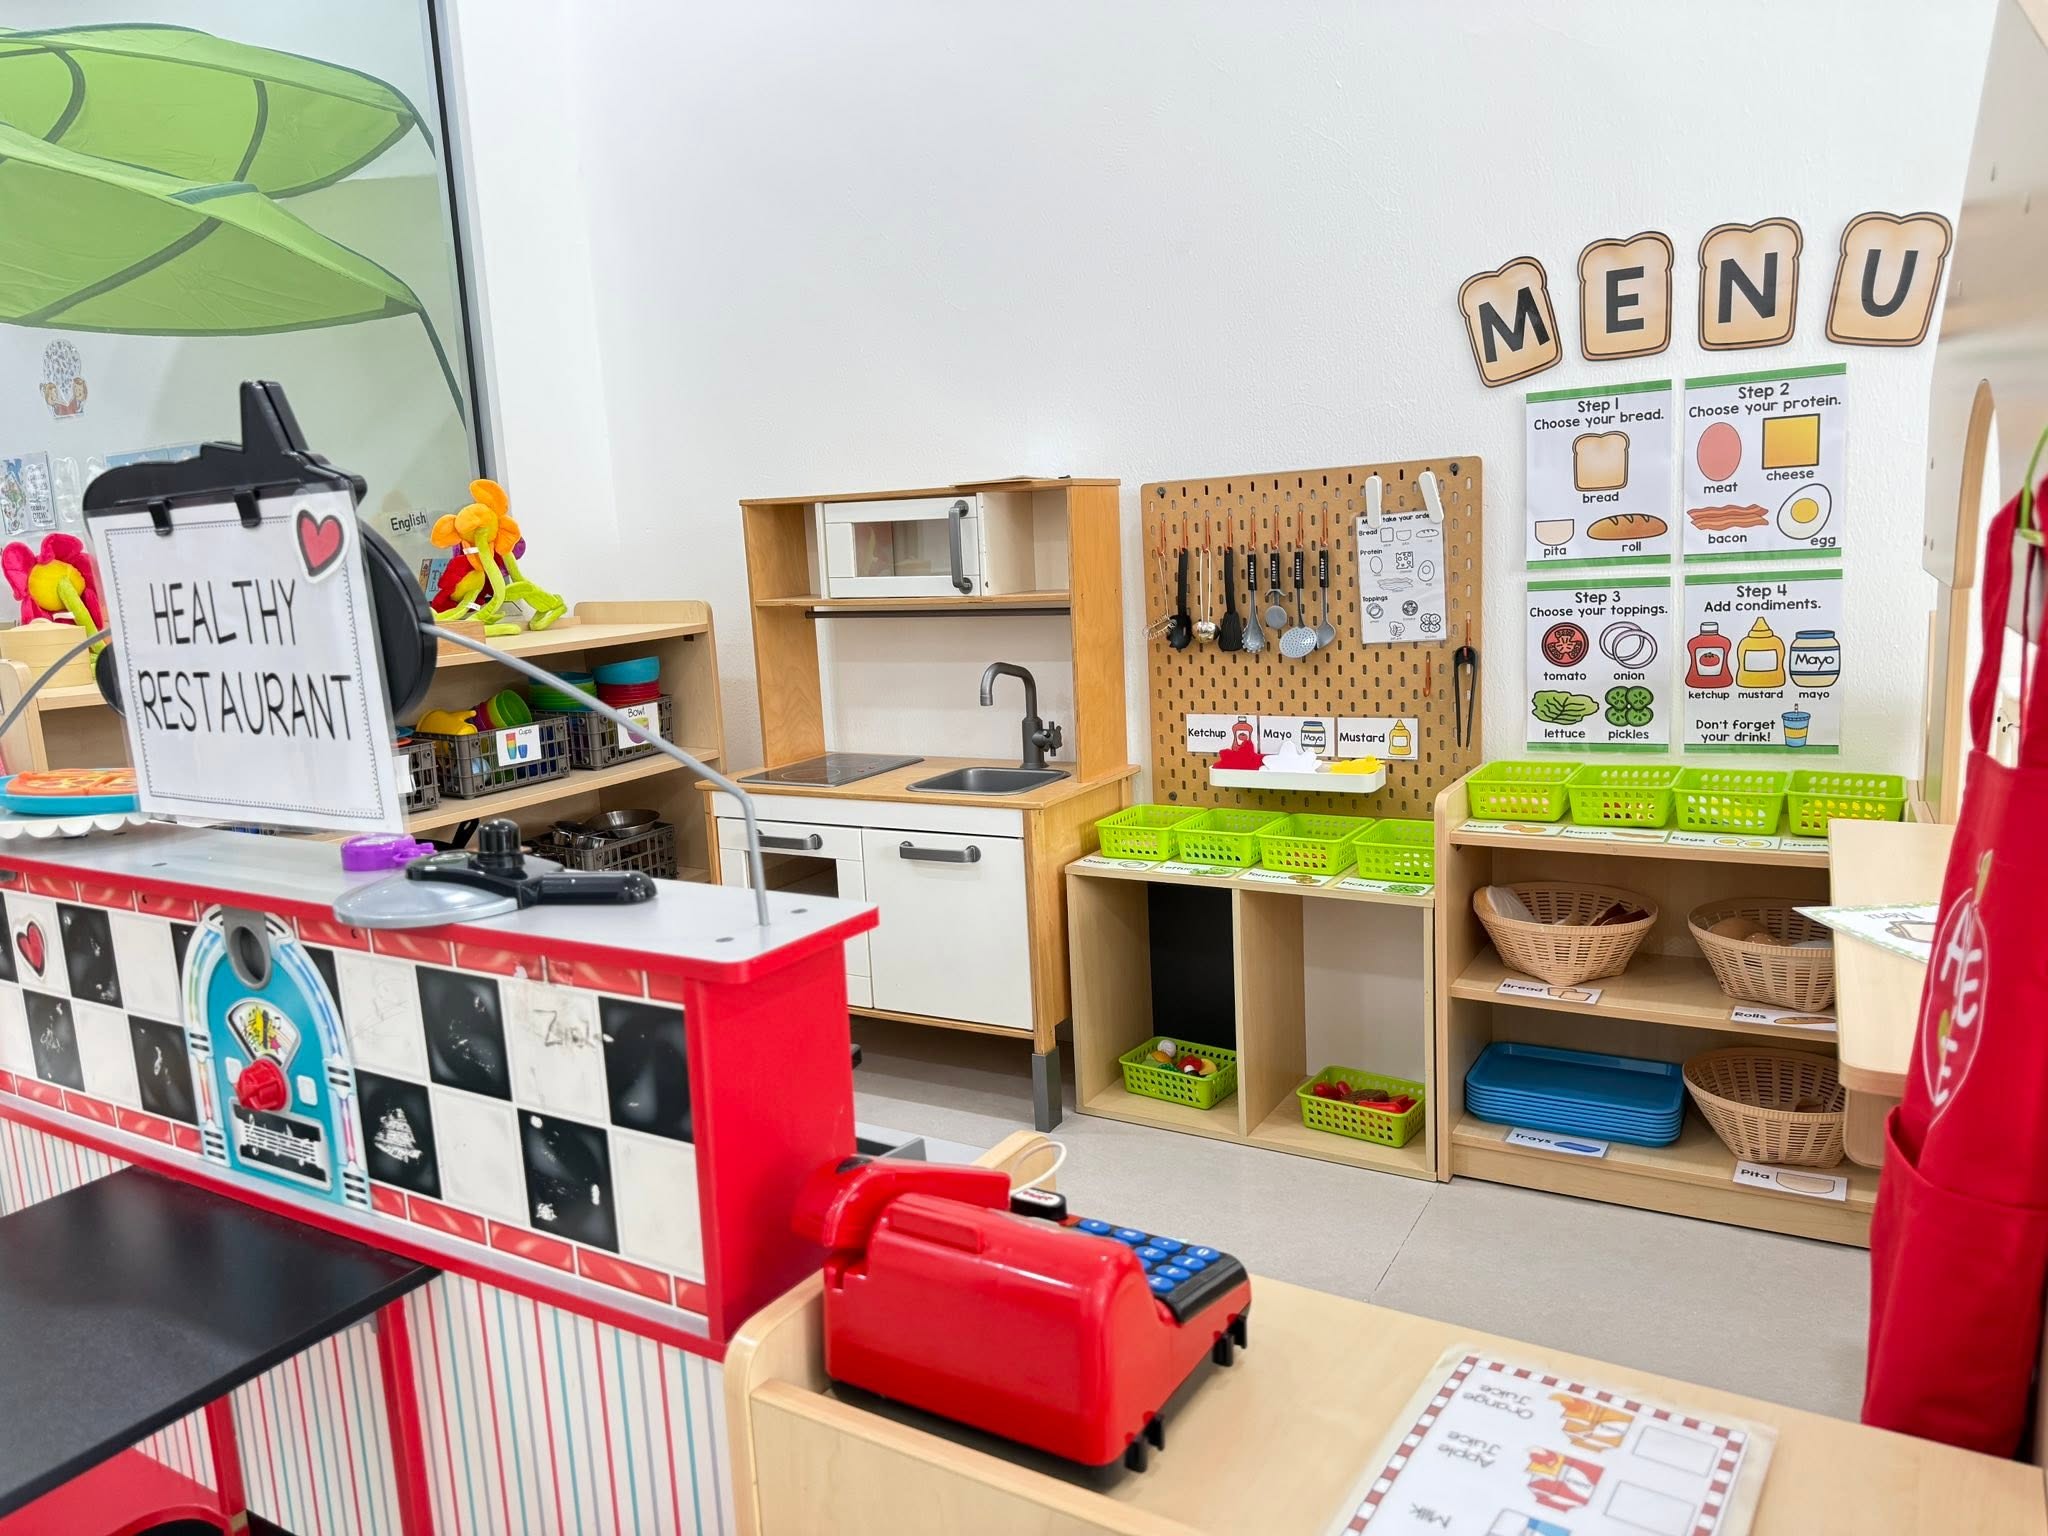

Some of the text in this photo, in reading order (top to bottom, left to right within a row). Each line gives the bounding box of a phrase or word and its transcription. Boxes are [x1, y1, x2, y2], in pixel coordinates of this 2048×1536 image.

[1477, 249, 1918, 365] MENU
[1739, 383, 1789, 400] Step 2
[1578, 401, 1610, 413] Step
[1689, 395, 1841, 417] Choose your protein.
[1534, 409, 1664, 430] Choose your bread.
[1766, 470, 1814, 481] cheese
[1704, 482, 1738, 493] meat
[1582, 491, 1619, 503] bread
[390, 512, 426, 531] English
[1708, 534, 1747, 544] bacon
[1810, 536, 1837, 547] egg
[1544, 545, 1566, 558] pita
[1622, 542, 1641, 552] roll
[1737, 584, 1787, 599] Step 4
[1575, 591, 1620, 605] Step 3
[1704, 598, 1821, 612] Add condiments.
[149, 578, 296, 647] HEALTHY
[1530, 605, 1667, 618] Choose your toppings.
[1795, 653, 1835, 670] Mayo
[1544, 672, 1586, 680] tomato
[1614, 671, 1645, 680] onion
[1689, 691, 1729, 700] ketchup
[1738, 690, 1783, 698] mustard
[1799, 692, 1829, 700] mayo
[137, 670, 352, 742] RESTAURANT
[628, 708, 645, 718] Bowl
[1696, 720, 1775, 731] Don't forget
[1188, 728, 1226, 739] Ketchup
[1264, 729, 1291, 740] Mayo
[1304, 733, 1323, 745] Mayo
[1340, 733, 1385, 742] Mustard
[1545, 729, 1585, 738] lettuce
[1608, 729, 1649, 740] pickles
[1701, 730, 1770, 743] your drink!
[1341, 880, 1383, 889] Pickles
[1502, 982, 1544, 993] Bread
[1734, 1011, 1767, 1021] Rolls
[1515, 1133, 1551, 1145] Trays
[1479, 1384, 1534, 1405] Juice
[1461, 1391, 1535, 1420] Orange
[1447, 1430, 1502, 1454] Juice
[1437, 1442, 1497, 1469] Apple
[1408, 1502, 1452, 1529] Milk
